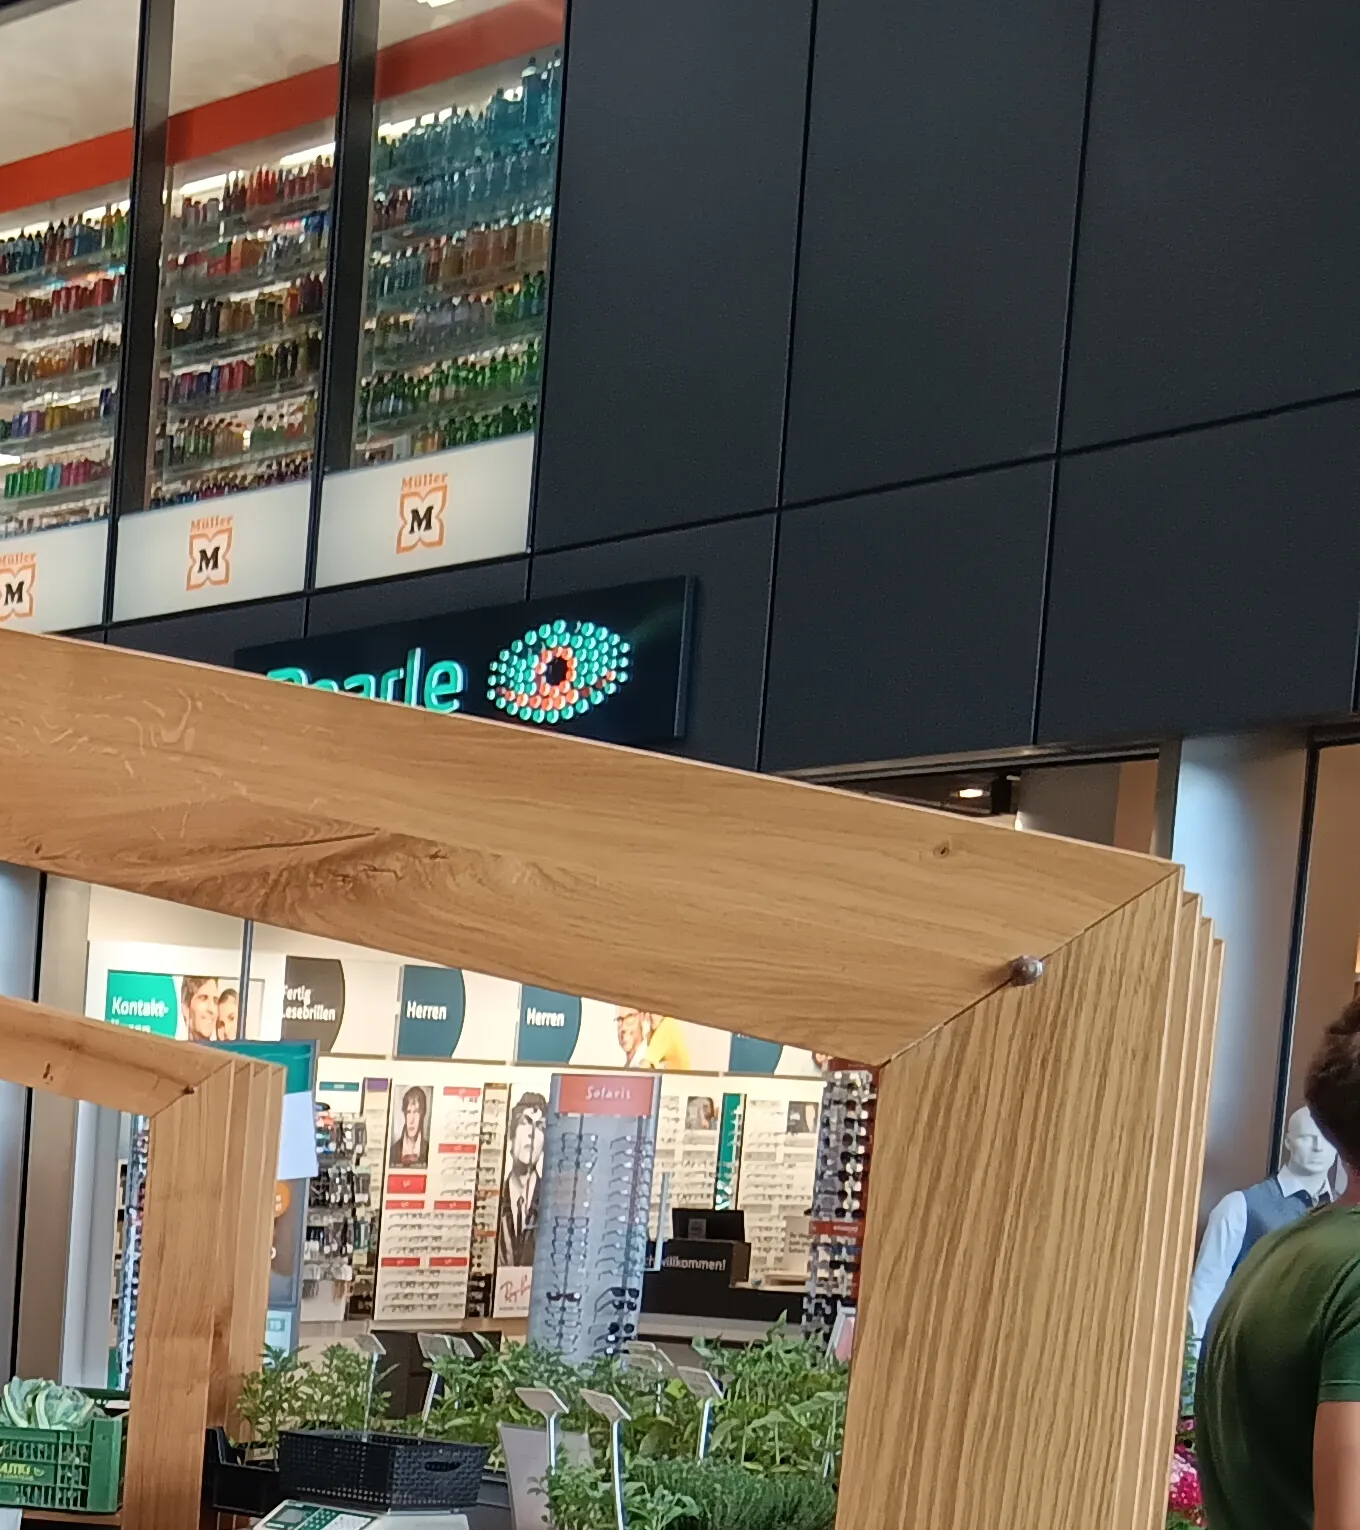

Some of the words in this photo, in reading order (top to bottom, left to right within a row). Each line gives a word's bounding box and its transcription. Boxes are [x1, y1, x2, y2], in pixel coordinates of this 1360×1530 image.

[401, 473, 449, 489] Müller
[190, 515, 234, 532] Müller
[112, 995, 169, 1019] Kontakt-
[407, 1000, 448, 1021] Herren
[526, 1006, 566, 1028] Herren
